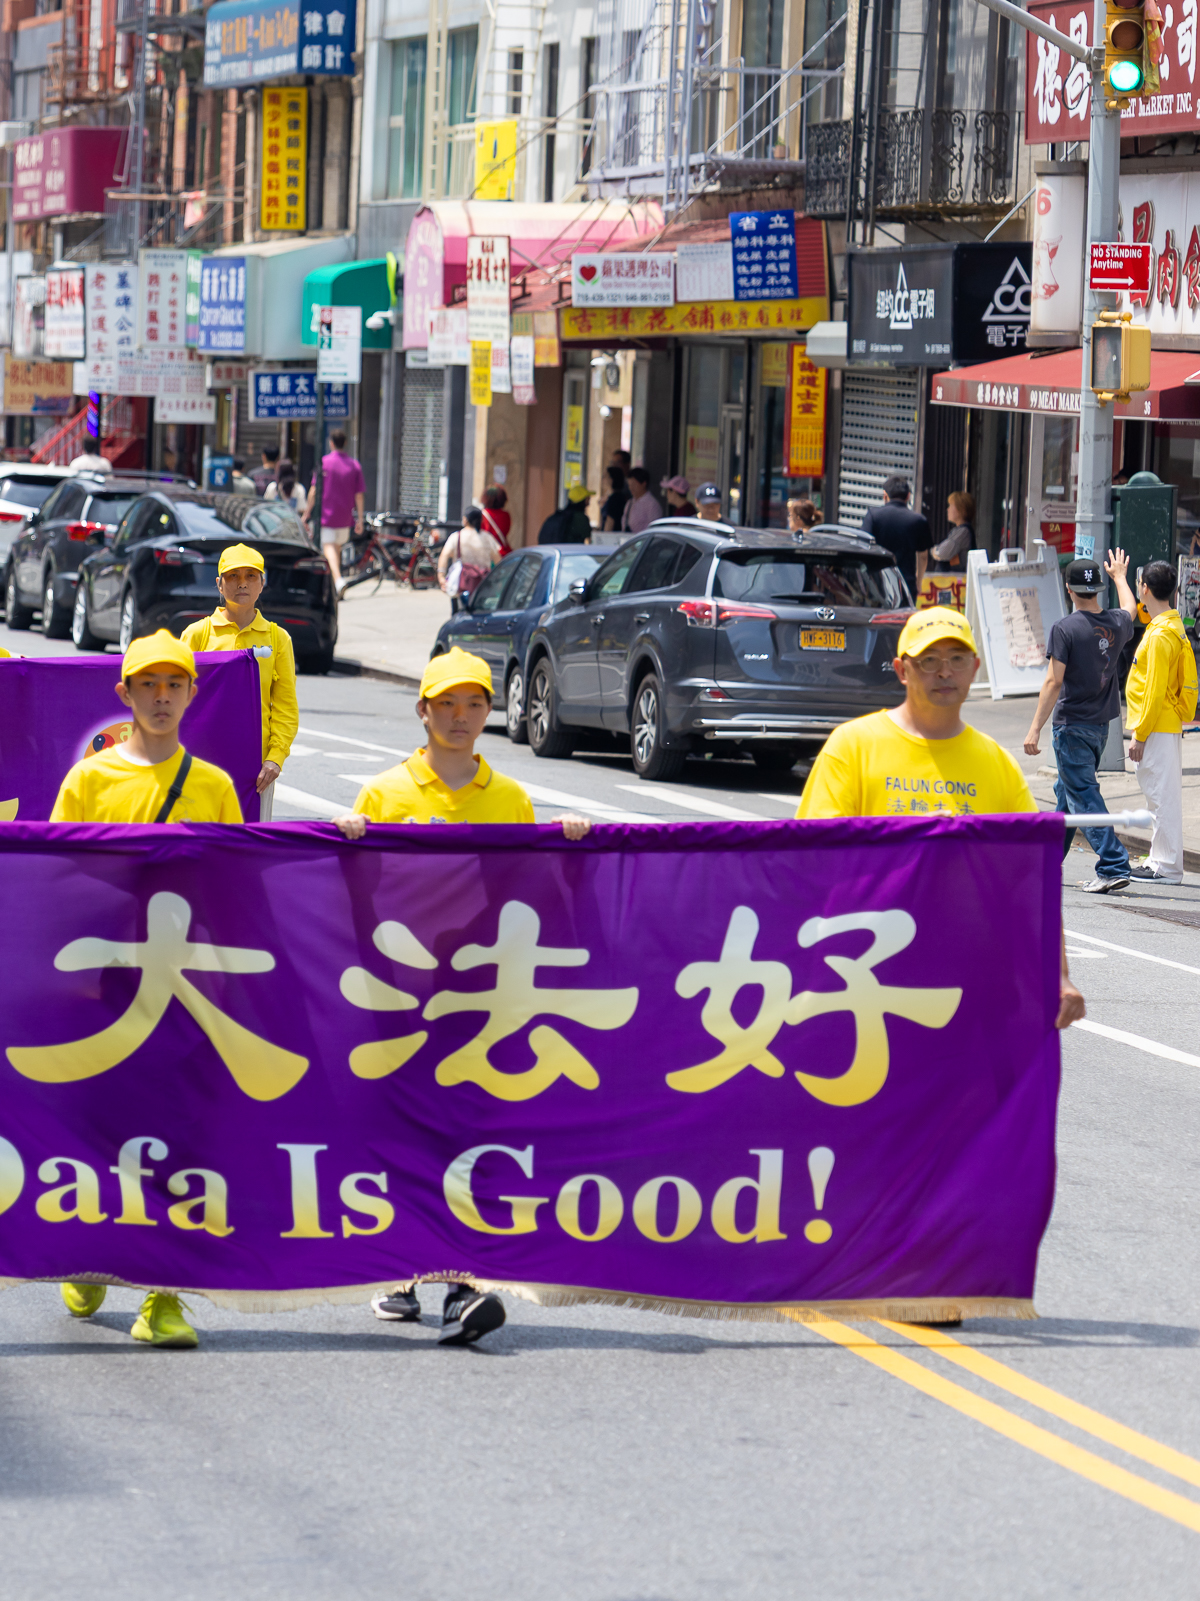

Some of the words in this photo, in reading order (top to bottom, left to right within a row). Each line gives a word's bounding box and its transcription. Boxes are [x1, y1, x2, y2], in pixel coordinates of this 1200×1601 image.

[1121, 98, 1137, 118] EAT
[1139, 94, 1174, 117] MARKET
[1093, 248, 1104, 258] NO
[1106, 247, 1142, 259] STANDING
[1130, 200, 1200, 309] 昌肉食
[1093, 259, 1124, 271] Anytime
[987, 325, 1031, 347] 電子
[1030, 390, 1039, 408] 99
[1038, 391, 1057, 411] MEAT
[1049, 523, 1061, 533] 2A
[886, 777, 930, 793] FALUN
[934, 780, 977, 797] GONG
[277, 1143, 395, 1239] Is
[443, 1142, 835, 1244] Good!
